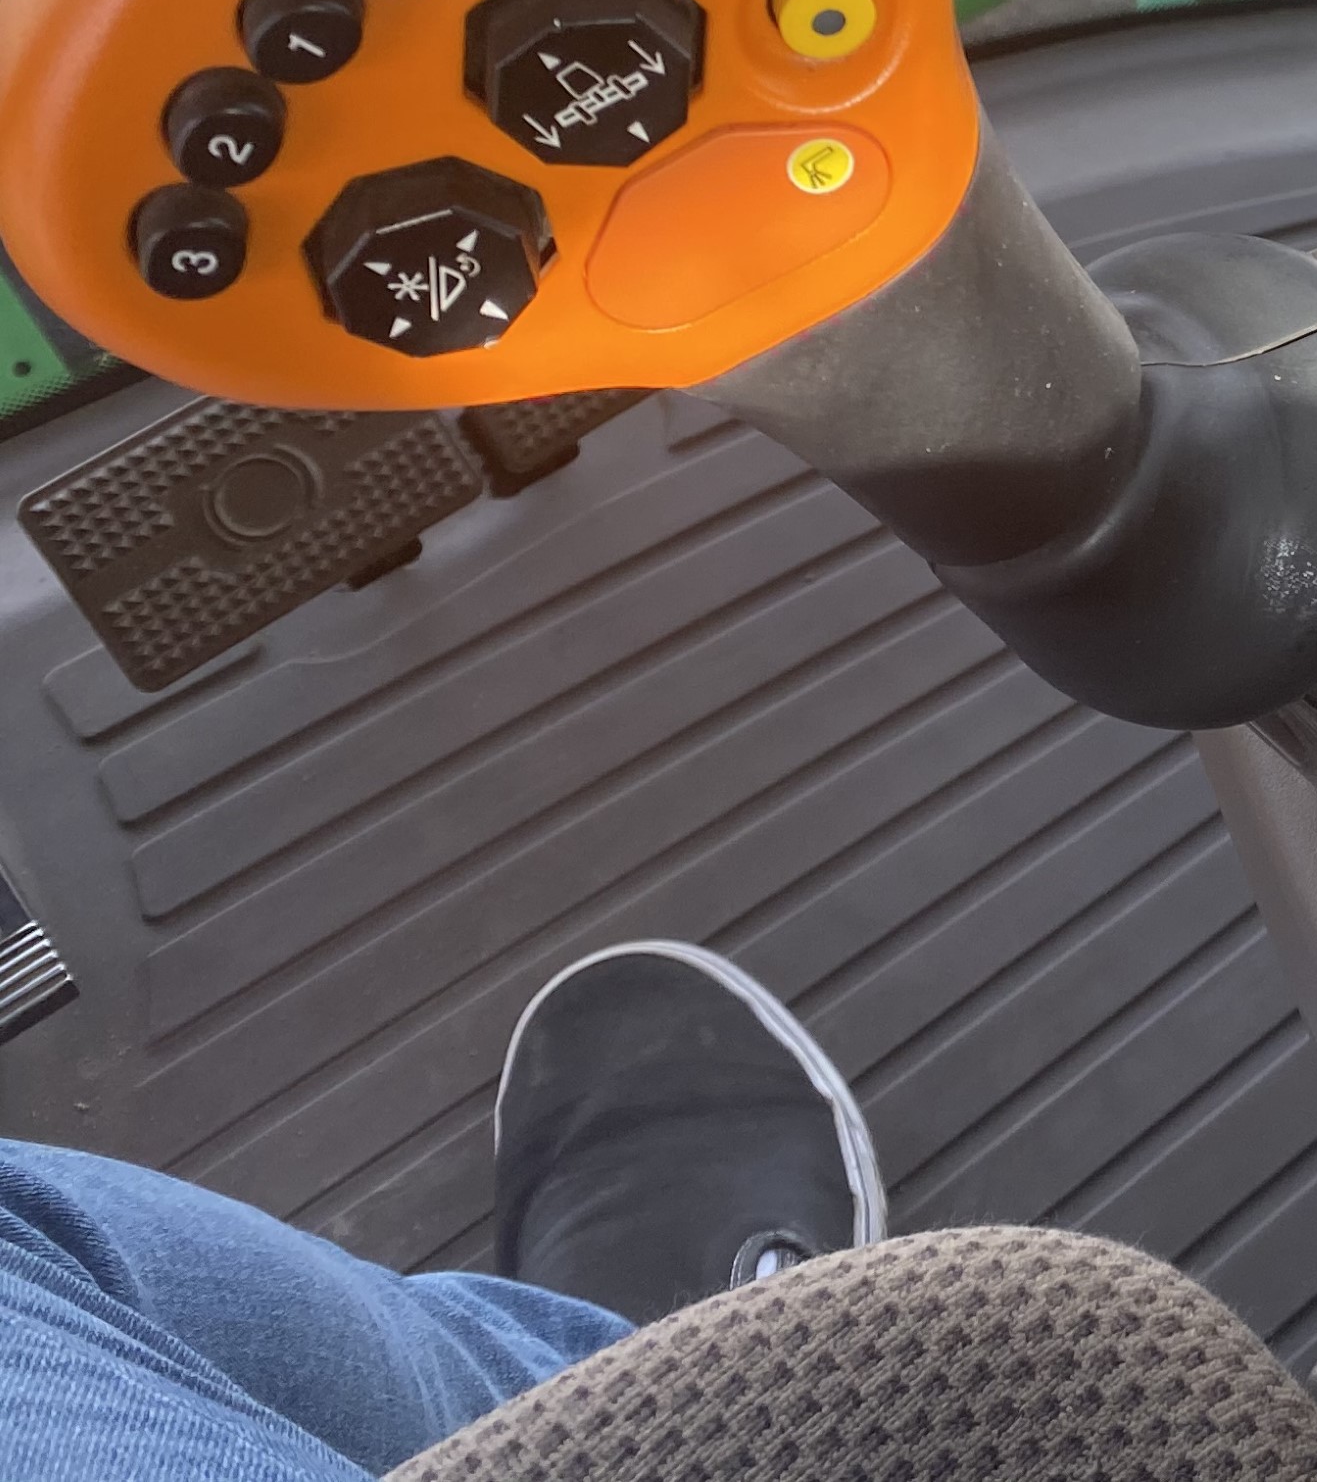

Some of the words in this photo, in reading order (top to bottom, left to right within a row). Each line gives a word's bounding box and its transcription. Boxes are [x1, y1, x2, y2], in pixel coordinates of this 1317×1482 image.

[287, 32, 326, 58] 1
[207, 134, 255, 166] 2
[171, 249, 219, 275] 3
